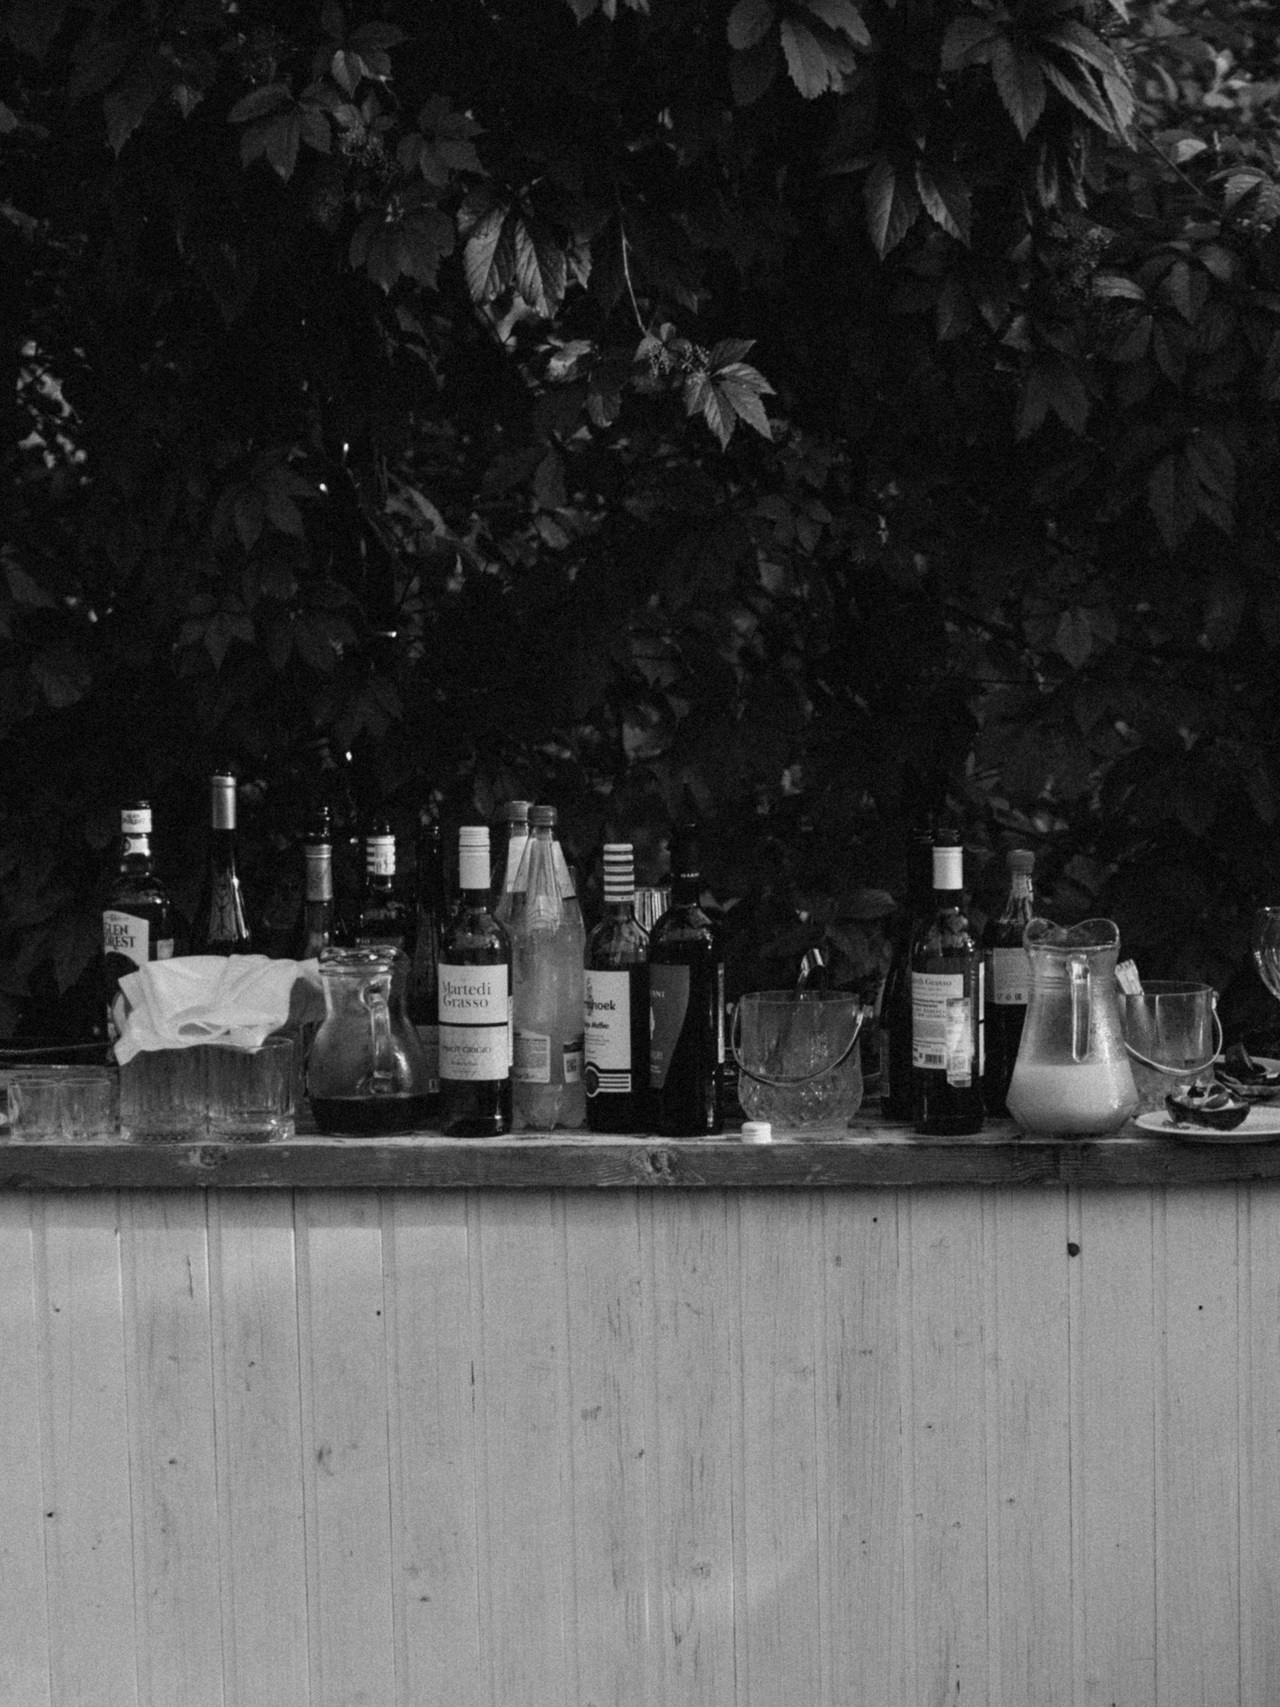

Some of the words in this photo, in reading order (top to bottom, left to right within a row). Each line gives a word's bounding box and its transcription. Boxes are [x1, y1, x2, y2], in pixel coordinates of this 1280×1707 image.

[104, 936, 136, 950] OREST
[442, 981, 492, 996] Martedi
[443, 994, 489, 1009] Grasso
